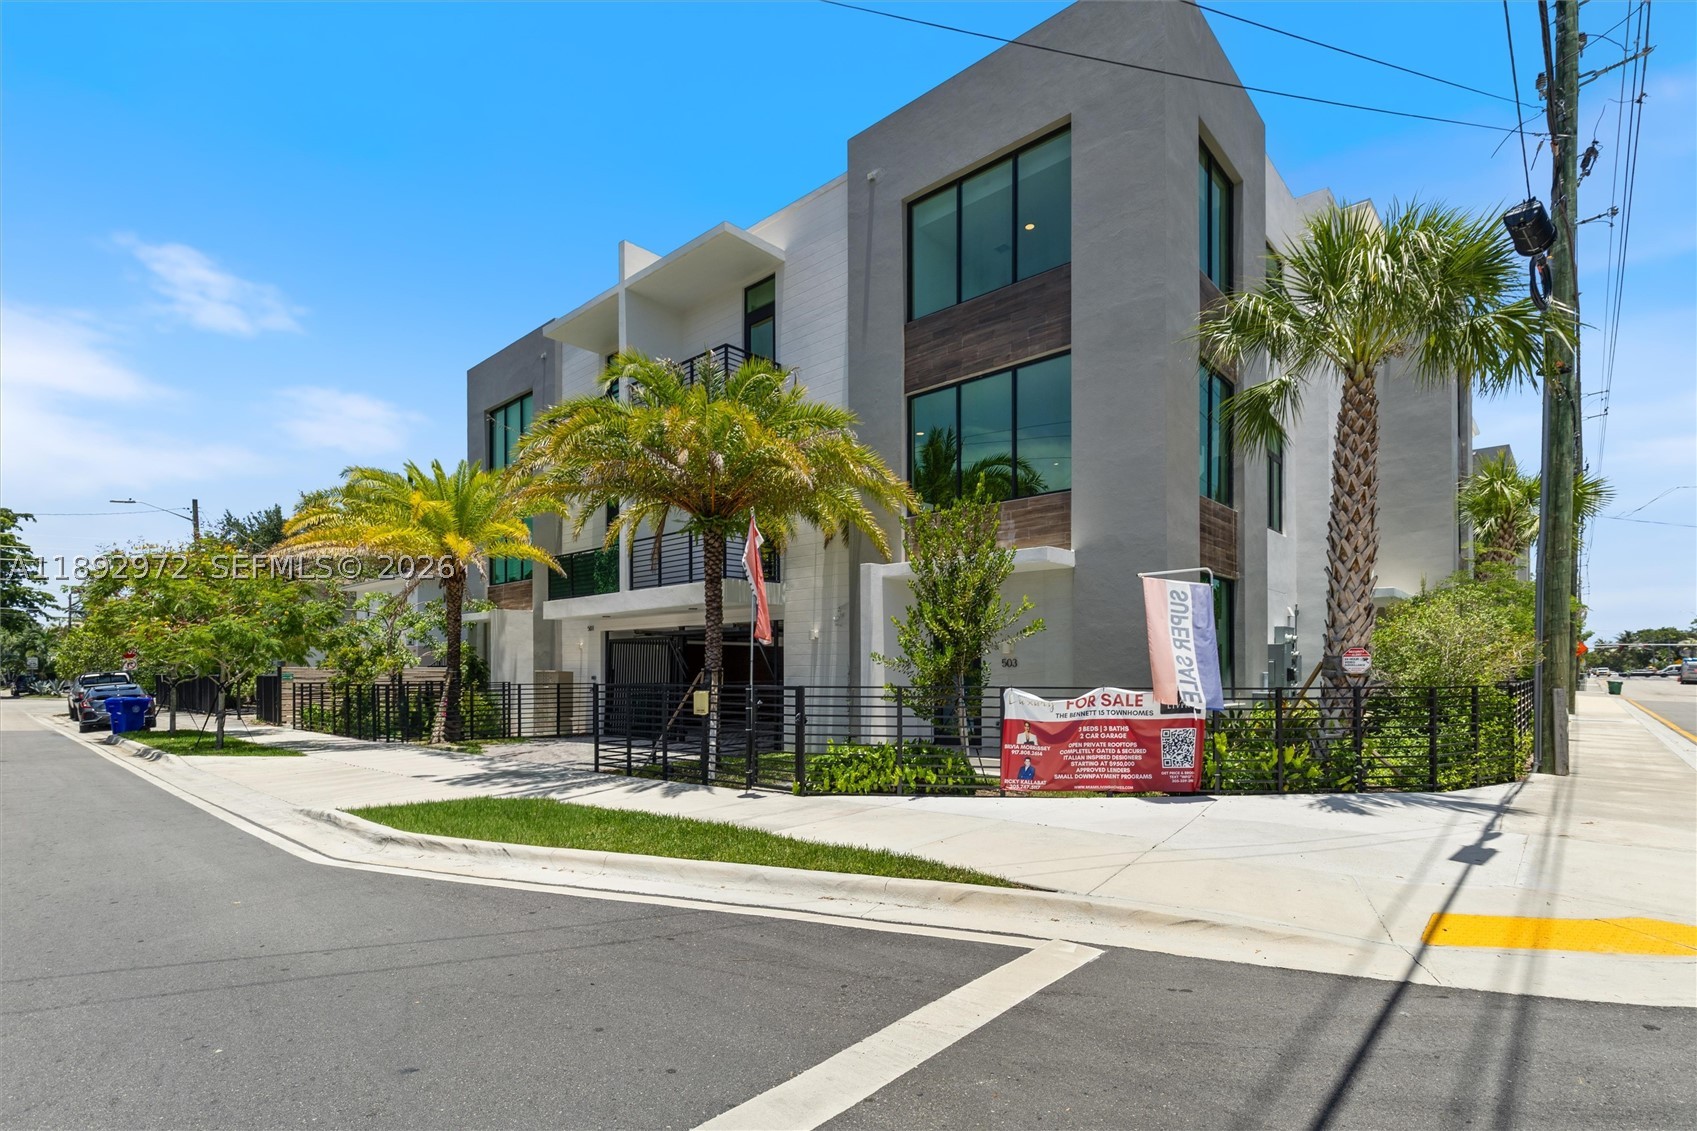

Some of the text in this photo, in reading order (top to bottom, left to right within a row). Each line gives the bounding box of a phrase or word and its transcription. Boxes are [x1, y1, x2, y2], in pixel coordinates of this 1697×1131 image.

[1001, 658, 1018, 668] 503
[1066, 693, 1143, 710] FOR SALE
[1069, 710, 1097, 718] BENNETT
